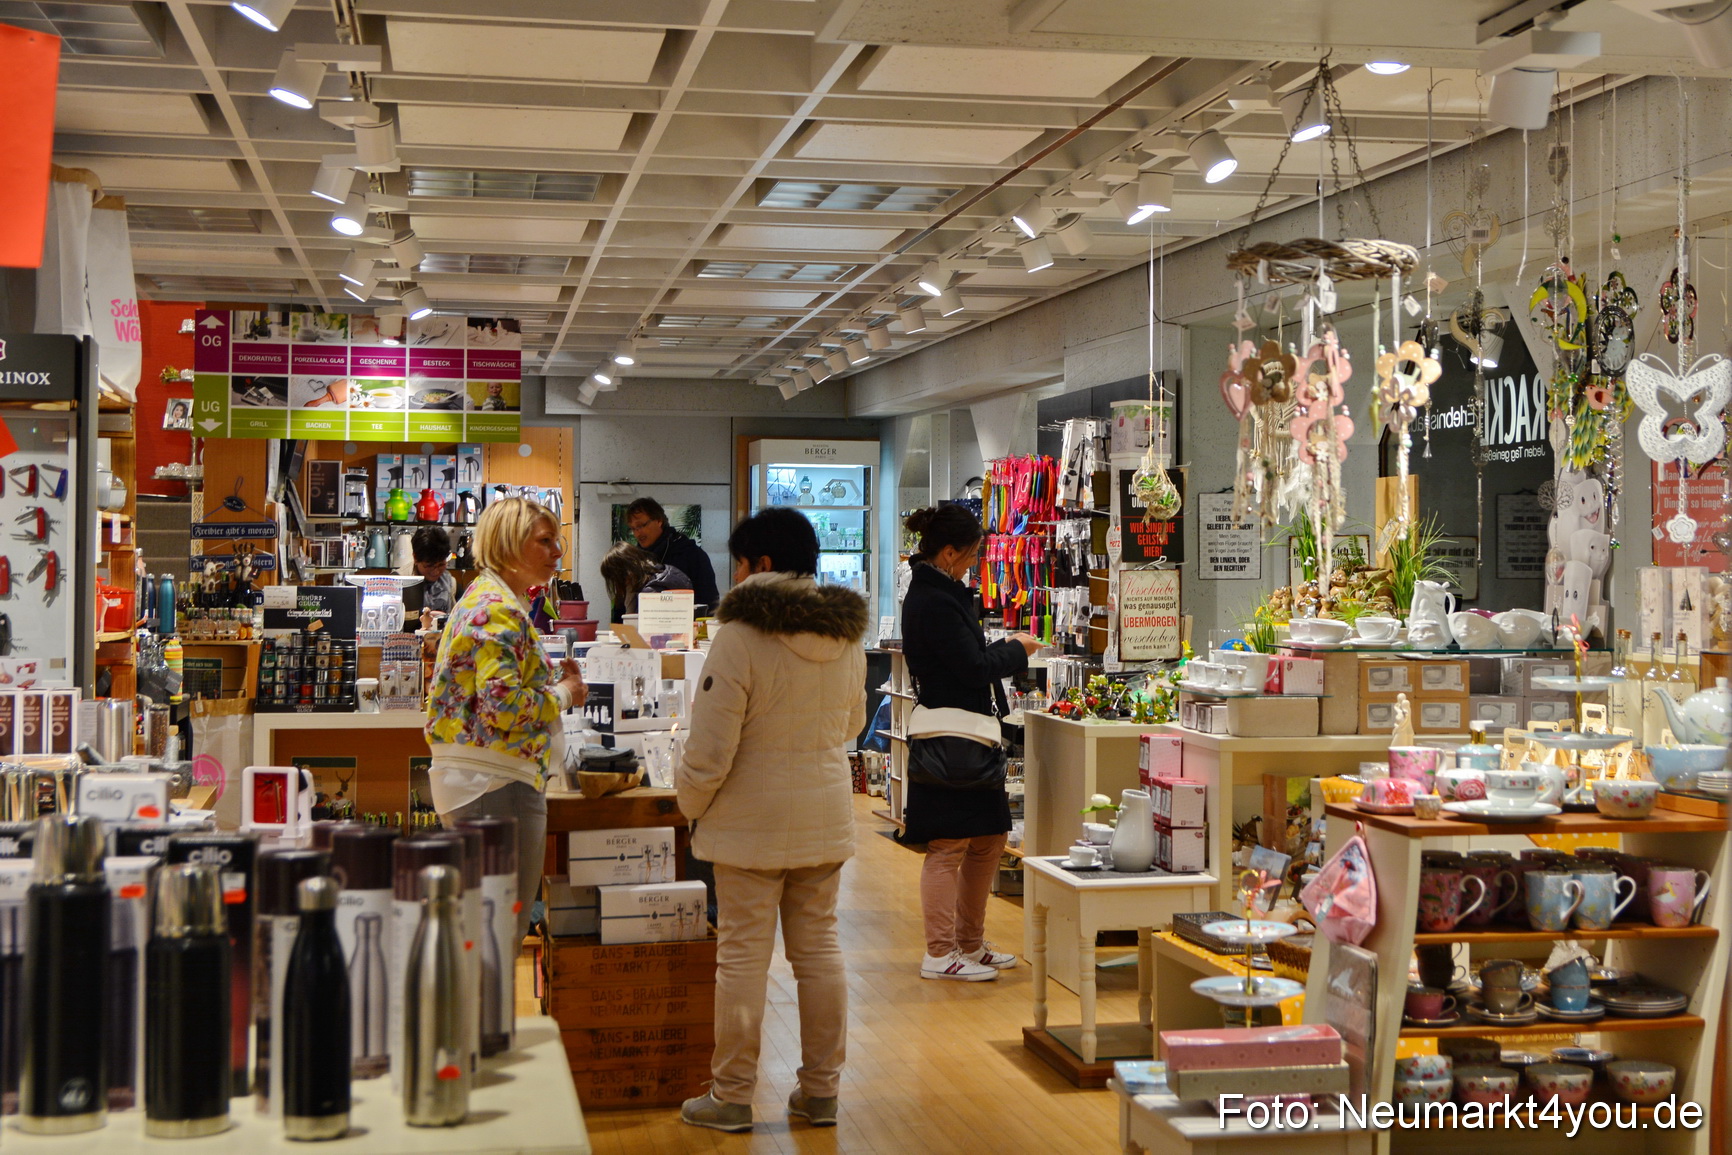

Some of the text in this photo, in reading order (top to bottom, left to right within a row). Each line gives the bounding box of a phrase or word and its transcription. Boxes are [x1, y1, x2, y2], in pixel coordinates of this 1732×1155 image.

[201, 335, 222, 347] OG
[238, 354, 282, 362] DEKORATIVES
[294, 356, 328, 364] PORZELLAN,
[359, 358, 398, 366] GESCHENKE
[472, 361, 517, 369] TISCHWÄSCHE
[200, 401, 221, 412] UG
[249, 420, 268, 428] GRILL
[1664, 497, 1688, 511] Dingn
[1690, 499, 1700, 508] so
[195, 526, 225, 537] Freibier
[247, 527, 275, 535] morgen
[1130, 522, 1144, 533] WIR
[1143, 546, 1163, 557] HIER!
[1124, 577, 1174, 596] Verschiebe
[1138, 602, 1177, 611] genausogut
[1124, 615, 1177, 628] ÜBERMORGEN
[23, 695, 40, 736] cilio
[52, 695, 69, 736] cilio
[86, 789, 123, 801] cilio
[606, 837, 637, 845] BERGER
[188, 847, 232, 864] cilio
[639, 895, 670, 903] BERGER
